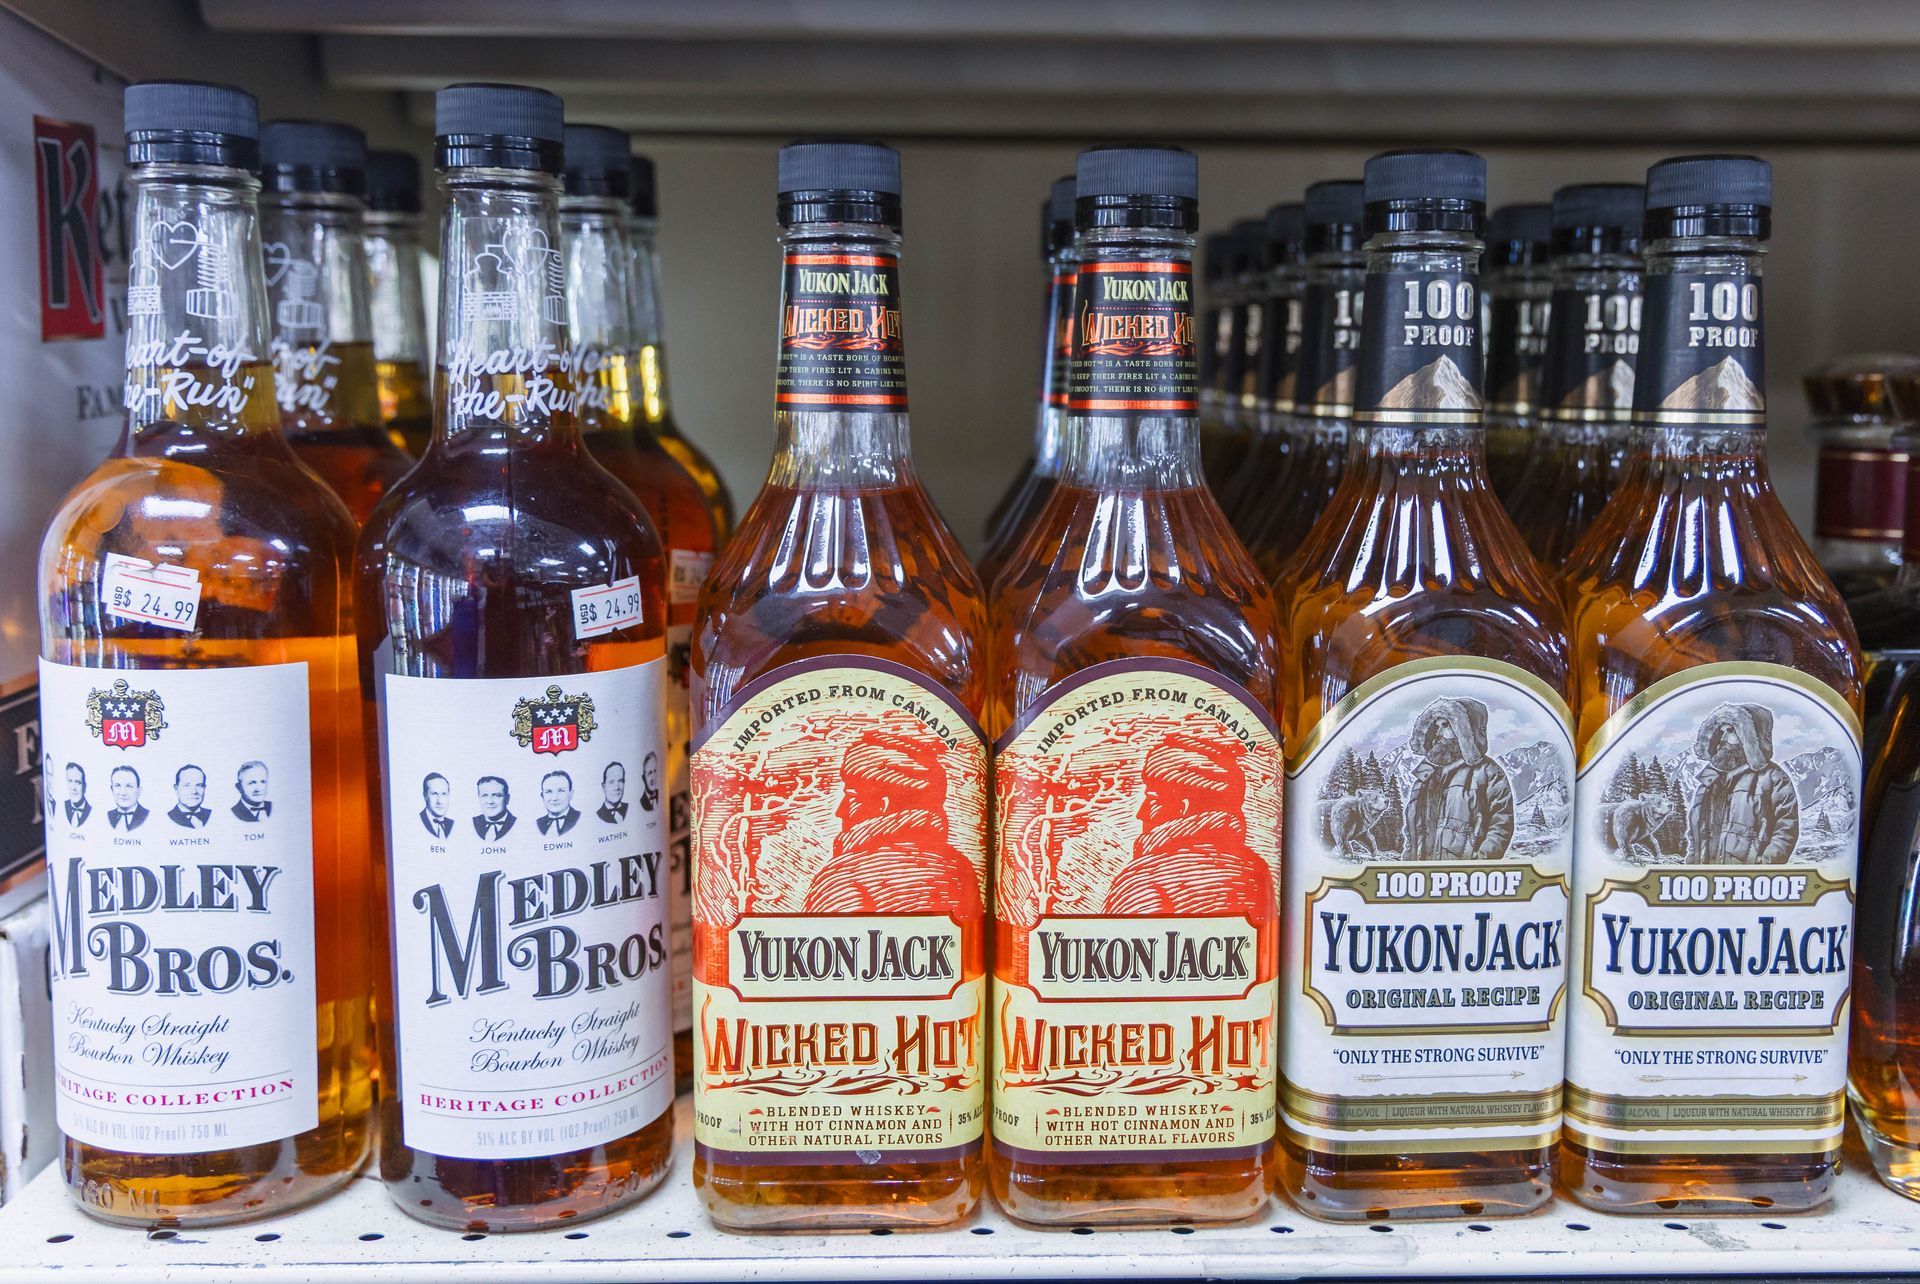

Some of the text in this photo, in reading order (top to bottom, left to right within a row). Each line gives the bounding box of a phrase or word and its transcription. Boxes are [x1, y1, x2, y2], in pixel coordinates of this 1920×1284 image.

[799, 268, 889, 295] YUKON JACK
[1103, 276, 1188, 302] YUKON JACK
[1404, 279, 1475, 321] 100
[1688, 281, 1758, 322] 100
[783, 305, 864, 339] WICKED
[1082, 312, 1169, 346] WICKED
[1403, 325, 1475, 347] PROOF
[1688, 326, 1758, 348] PROOF
[812, 366, 835, 374] FIRES
[864, 367, 891, 375] CABINS
[847, 354, 868, 362] BORN
[798, 379, 823, 387] THERE
[852, 380, 877, 388] SPIRIT
[1104, 385, 1131, 393] THERE
[1133, 385, 1142, 393] IS
[141, 593, 194, 622] 24.99
[605, 593, 640, 620] 24.99
[733, 685, 959, 752] IMPORTED FROM CANADA
[1037, 688, 1258, 755] IMPORTED FROM CANADA
[113, 838, 141, 846] EDWIN
[169, 838, 210, 846] WATHEN
[244, 833, 265, 841] TOM
[430, 845, 446, 853] BEN
[543, 841, 573, 851] EDWIN
[597, 831, 628, 844] WATHEN
[480, 846, 507, 855] JOHN
[1376, 870, 1522, 898] 100 PROOF
[1659, 875, 1807, 901] 100 PROOF
[412, 851, 664, 1009] MEDLEY
[1320, 911, 1463, 973] YUKON
[737, 930, 861, 981] YUKON
[1037, 930, 1158, 983] YUKON
[1602, 913, 1747, 975] YUKON
[87, 921, 295, 997] BROS.
[506, 921, 667, 1001] BROS.
[1346, 985, 1540, 1009] ORIGINAL RECIPE
[1627, 990, 1824, 1010] ORIGINAL RECIPE
[67, 1001, 230, 1044] Kentucky Straight
[469, 1000, 641, 1049] Kentucky Straight
[68, 1032, 231, 1072] Bourbon Whiskey
[470, 1030, 641, 1074] Bourbon Whiskey
[702, 1013, 981, 1076] WICKED HOT
[1003, 1015, 1174, 1075] WICKED
[1384, 1050, 1411, 1064] THE
[1415, 1048, 1475, 1063] STRONG
[1663, 1051, 1693, 1065] THE
[1696, 1050, 1757, 1065] STRONG
[57, 1072, 294, 1106] RITAGE COLLECTION
[420, 1054, 669, 1112] HERITAGE COLLECTION
[766, 1105, 926, 1117] BLENDED WHISKEY
[1062, 1104, 1220, 1117] BLENDED WHISKEY
[1392, 1105, 1425, 1117] LIQUEUR
[1427, 1105, 1448, 1117] WITH
[1450, 1104, 1486, 1116] NATURAL
[1487, 1103, 1523, 1116] WHISKEY
[1524, 1101, 1549, 1114] FLAVOR
[1673, 1106, 1707, 1118] LIQUEUR
[1708, 1106, 1730, 1118] WITH
[1731, 1106, 1768, 1118] NATURAL
[1769, 1106, 1805, 1117] WHISKEY
[191, 1124, 209, 1139] 750
[215, 1122, 229, 1137] ML
[499, 1131, 517, 1145] ALC
[521, 1130, 534, 1144] BY
[537, 1128, 554, 1143] VOL
[750, 1118, 942, 1132] WITH HOT CINNAMON AND
[1047, 1117, 1235, 1132] WITH HOT CINNAMON AND
[748, 1132, 943, 1146] OTHER NATURAL FLAVORS
[1044, 1131, 1235, 1146] OTHER NATURAL FLAVORS
